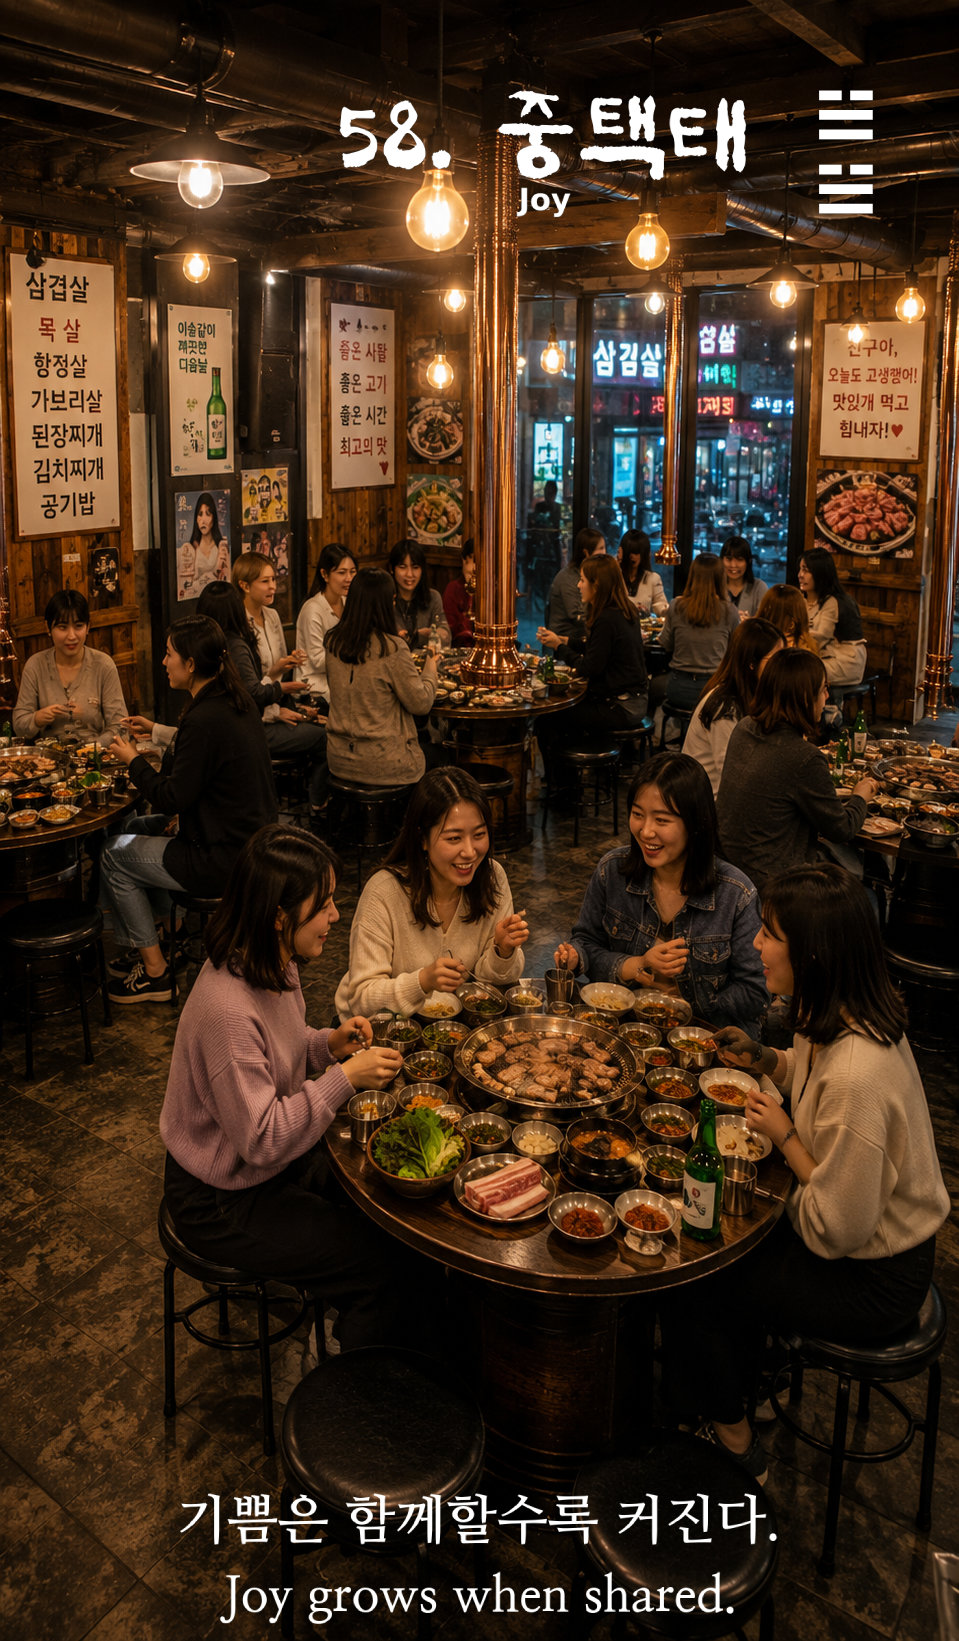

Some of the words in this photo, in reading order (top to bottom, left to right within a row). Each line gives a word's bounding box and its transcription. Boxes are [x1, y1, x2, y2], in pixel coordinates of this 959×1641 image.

[25, 271, 89, 304] 삼겹살
[38, 317, 57, 343] 목
[63, 318, 81, 344] 살
[33, 351, 88, 379] 항정살
[365, 404, 388, 426] 시간
[880, 393, 910, 413] 먹고
[31, 422, 103, 449] 된장찌개
[33, 456, 104, 485] 김치찌개
[40, 490, 96, 520] 공기밥
